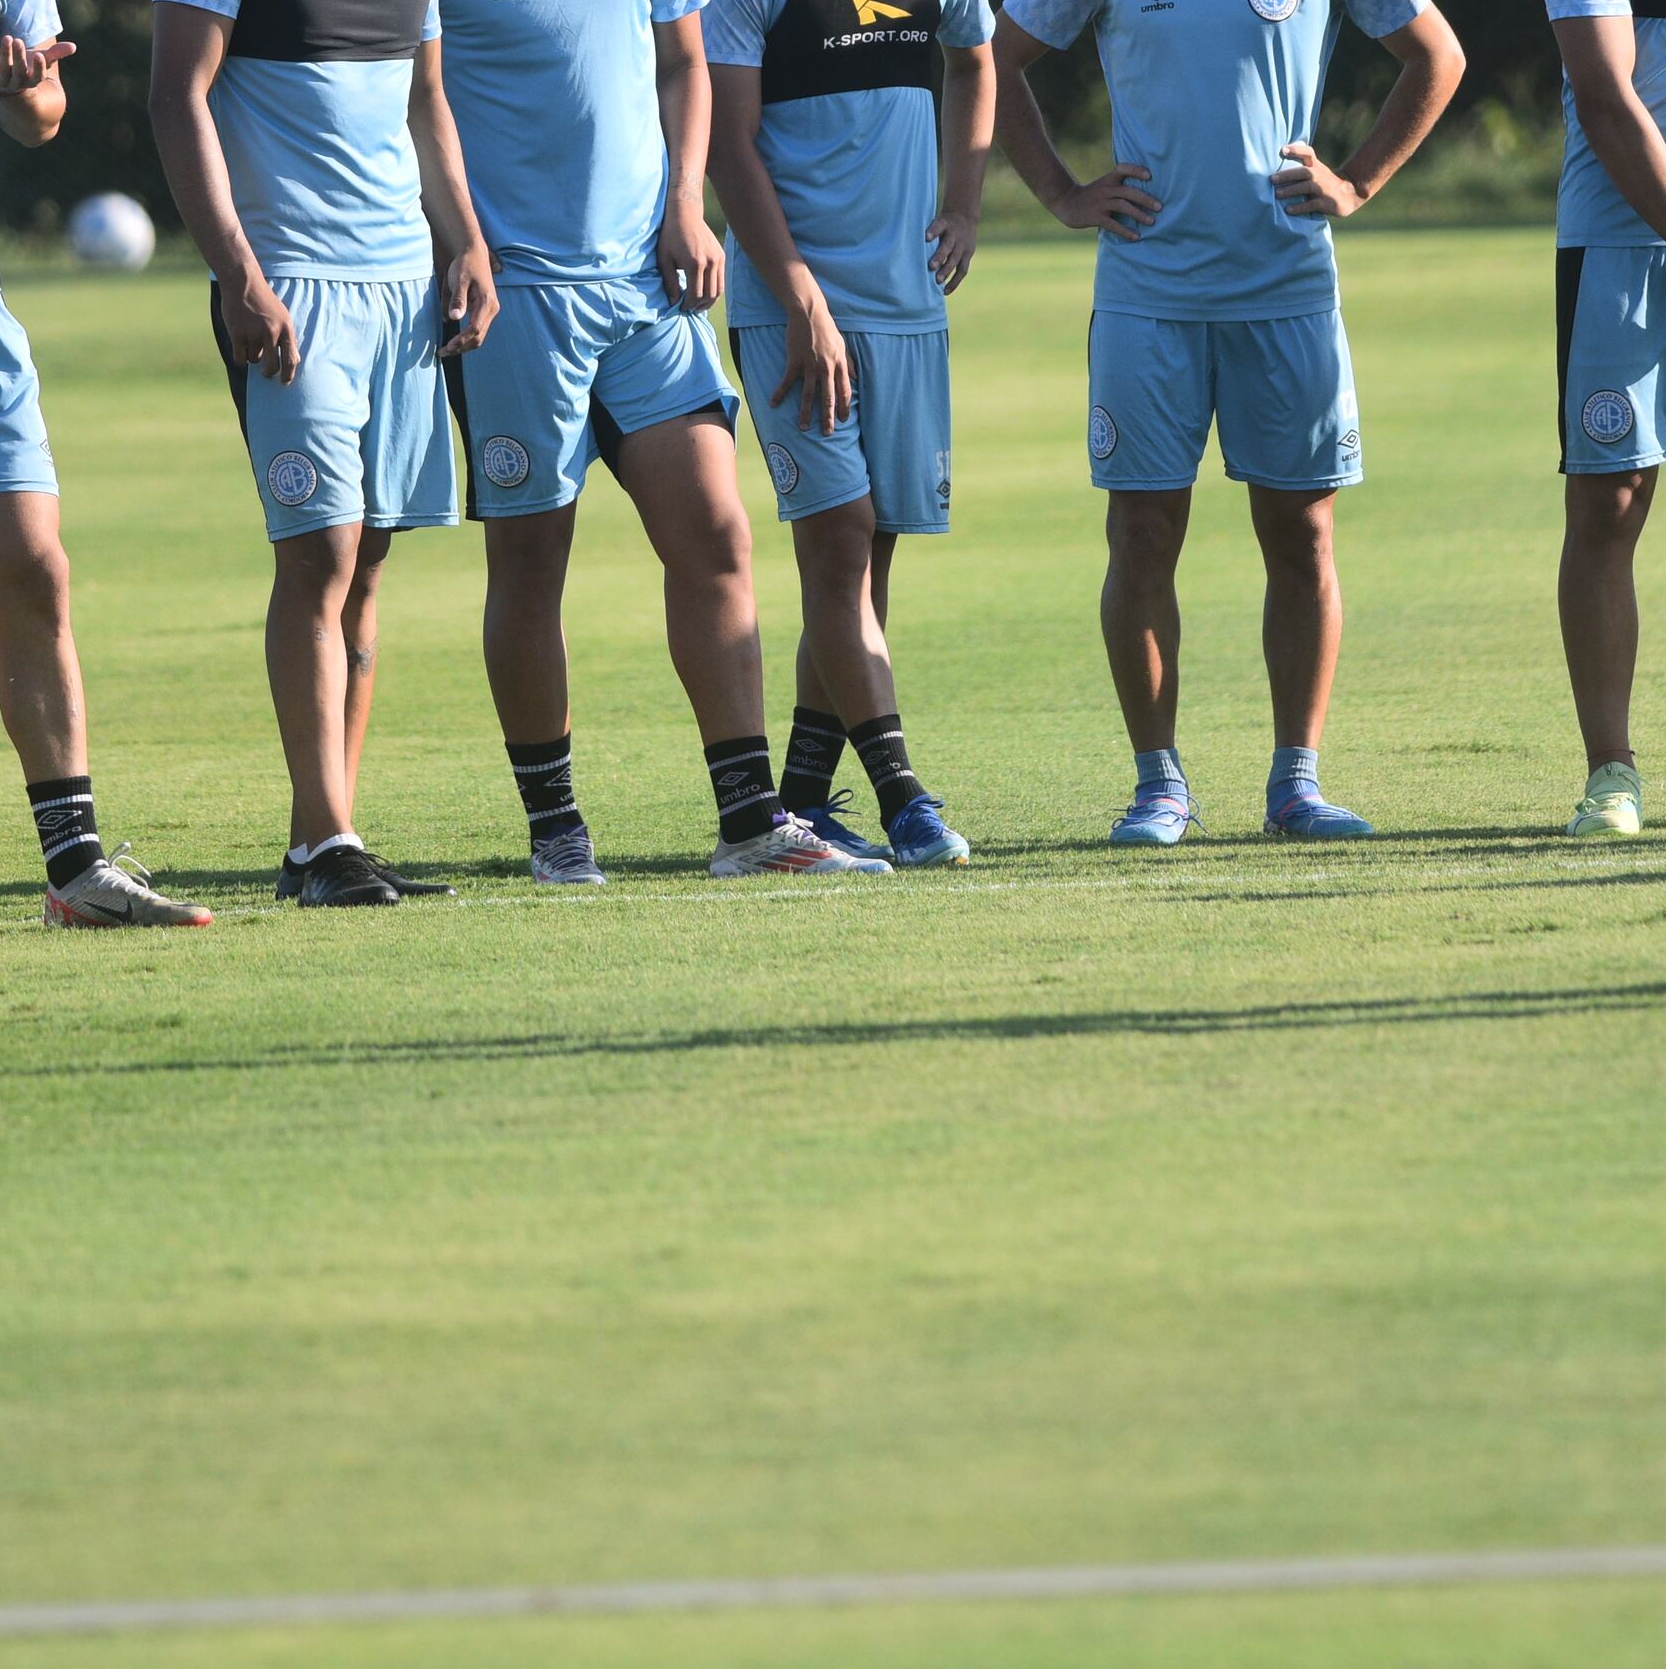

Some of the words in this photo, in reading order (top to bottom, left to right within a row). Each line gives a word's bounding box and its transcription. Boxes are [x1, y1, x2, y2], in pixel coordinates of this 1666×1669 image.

[1141, 1, 1175, 13] umbro
[823, 29, 929, 50] K-SPORT.ORG
[720, 783, 760, 805] umbro
[43, 825, 82, 846] umbro
